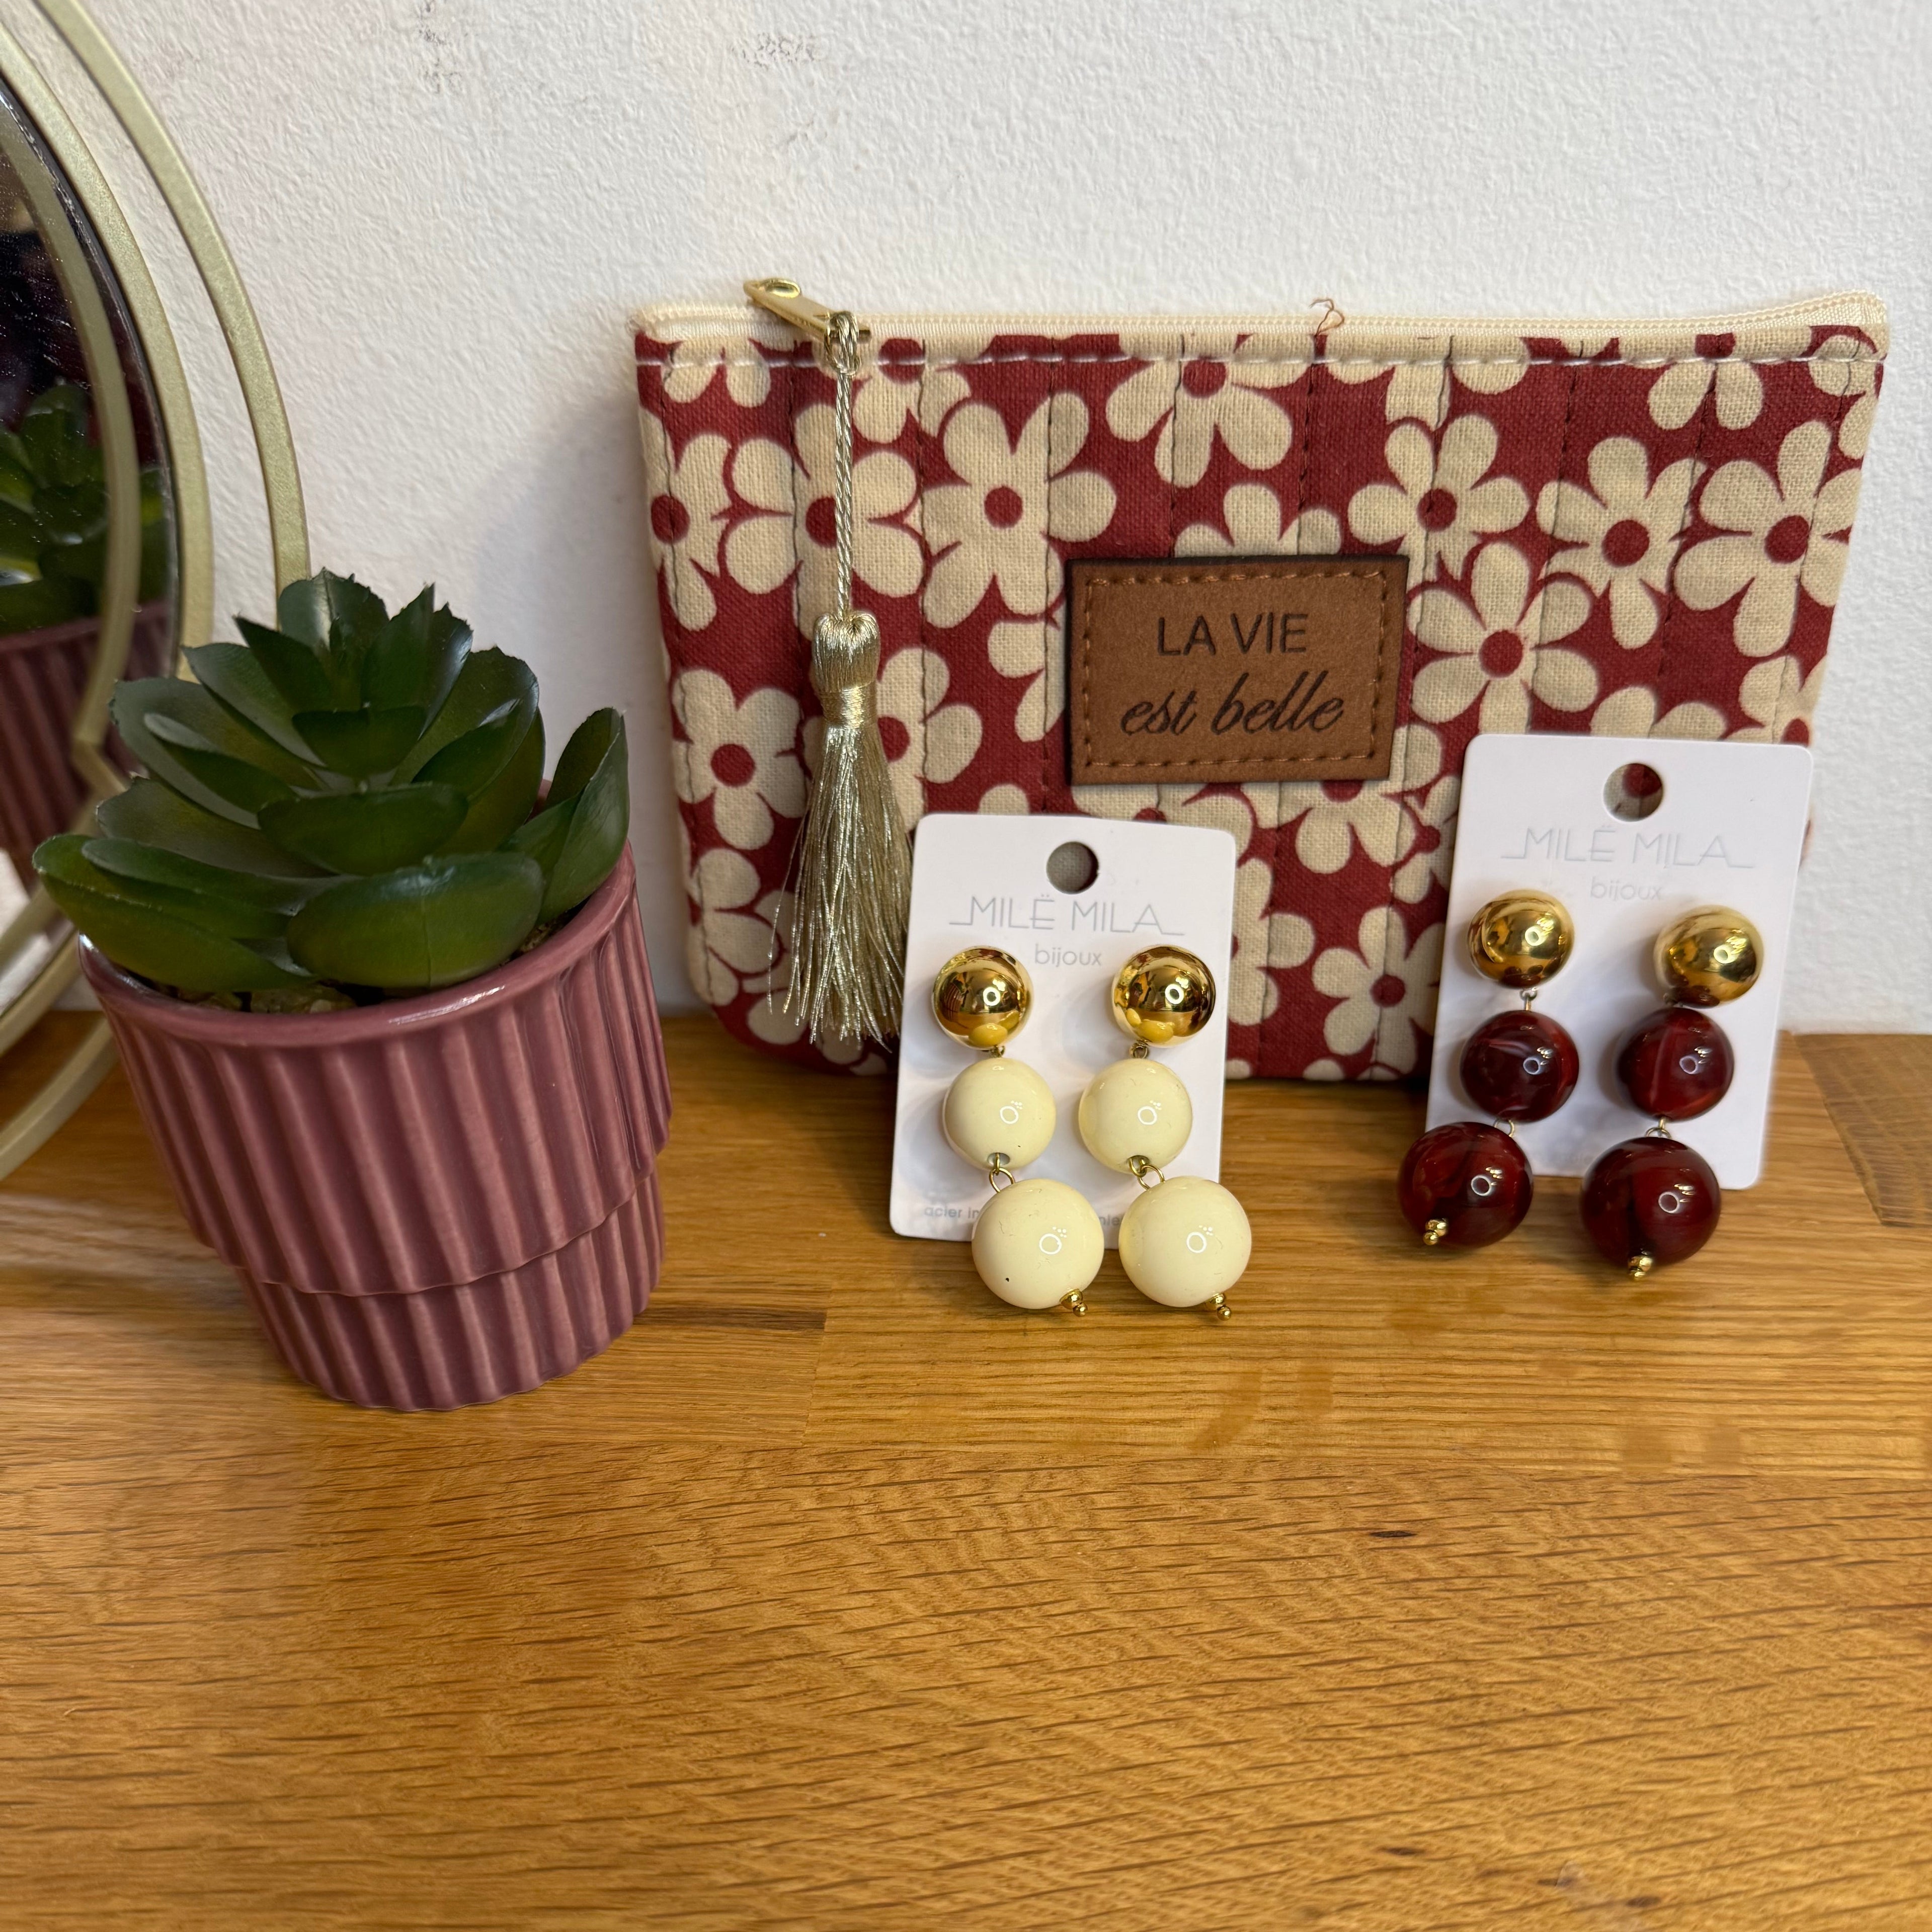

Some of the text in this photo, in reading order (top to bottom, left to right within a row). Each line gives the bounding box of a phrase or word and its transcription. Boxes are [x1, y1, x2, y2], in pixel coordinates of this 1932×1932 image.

[1158, 612, 1308, 656] LA VIE
[1120, 670, 1344, 736] est belle
[1500, 824, 1754, 868] MILË MILA
[1590, 876, 1662, 901] bijoux
[949, 894, 1185, 935] MILË MILA
[1034, 943, 1102, 968] bijoux
[924, 1206, 962, 1218] acier
